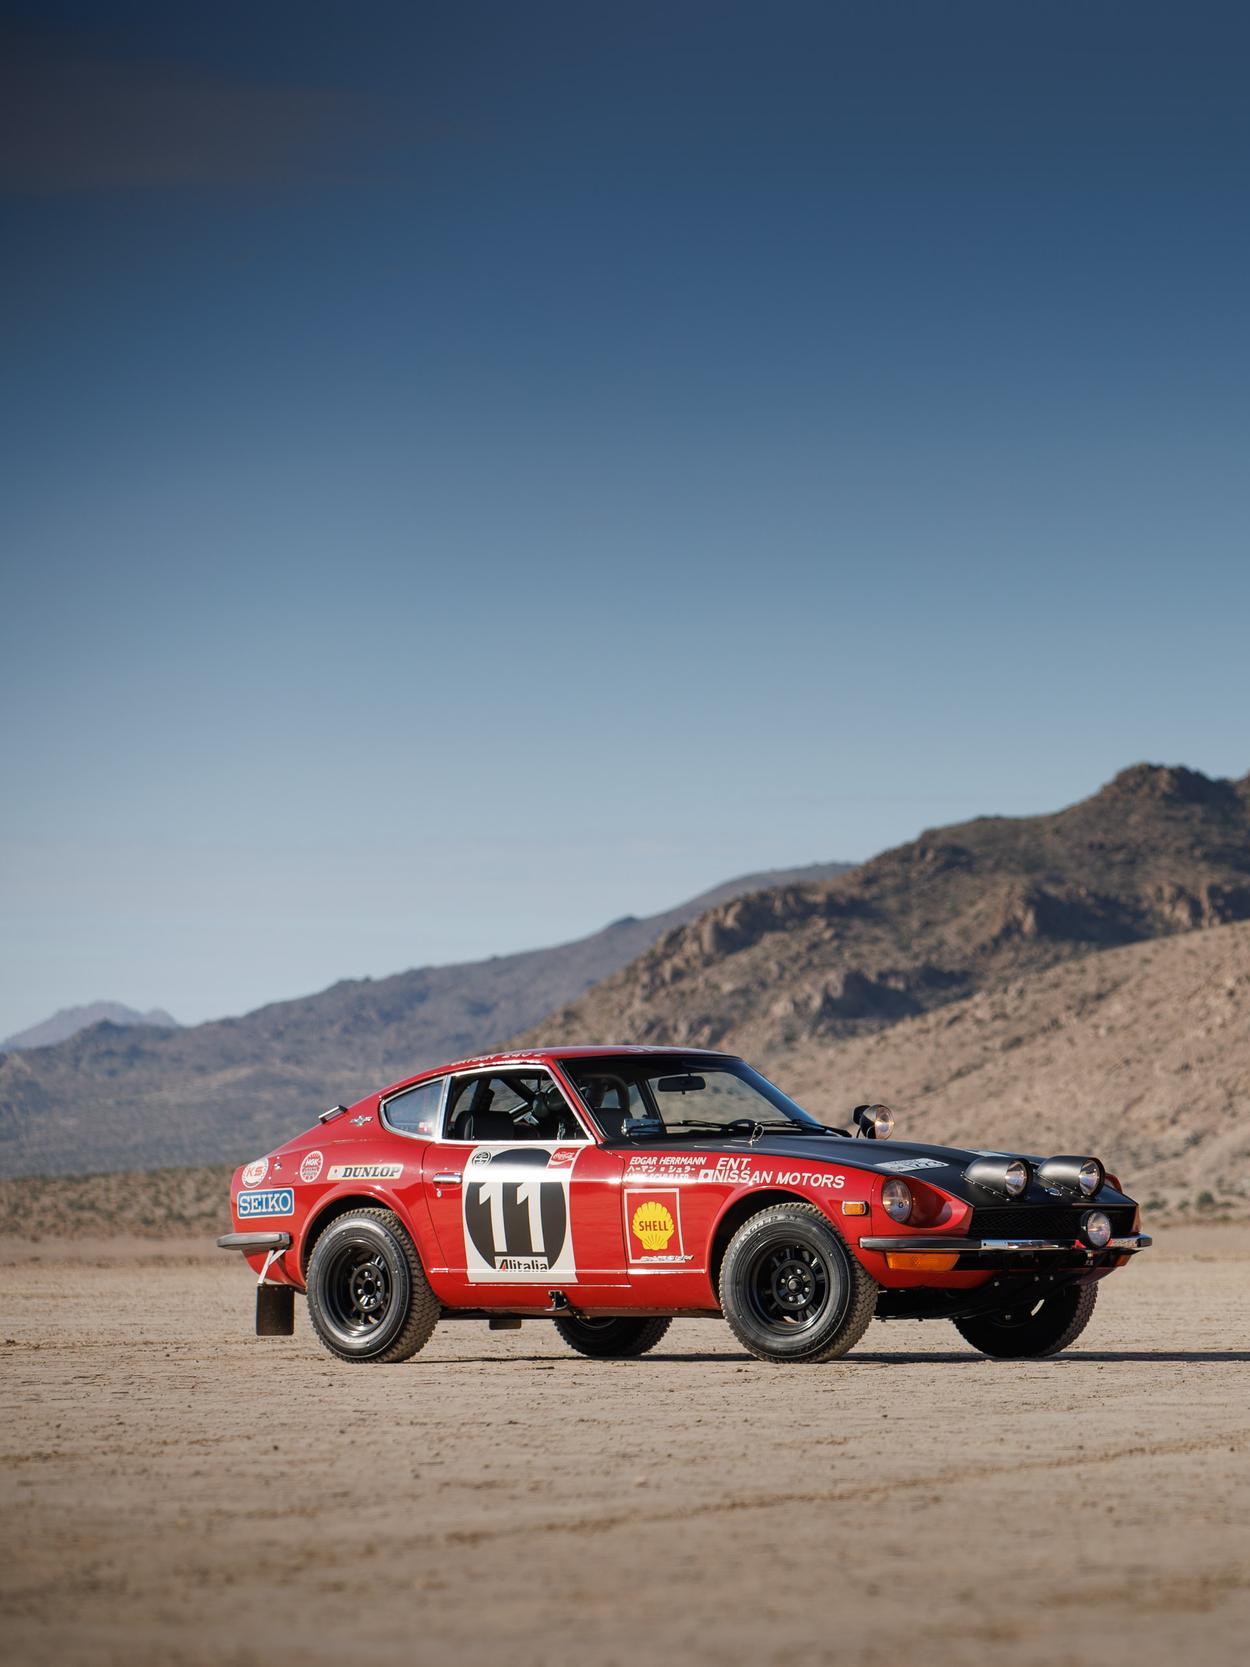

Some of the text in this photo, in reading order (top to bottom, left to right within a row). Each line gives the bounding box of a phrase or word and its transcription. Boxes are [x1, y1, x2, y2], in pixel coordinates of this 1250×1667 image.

[629, 1156, 707, 1165] EDGAR HERRMANN
[716, 1157, 751, 1170] ENT.
[342, 1166, 400, 1178] DUNLOP
[713, 1169, 846, 1188] NISSAN MOTORS
[239, 1192, 291, 1214] SEIKO
[479, 1181, 546, 1253] 11
[639, 1220, 669, 1232] SHELL
[499, 1259, 548, 1272] Alitalia
